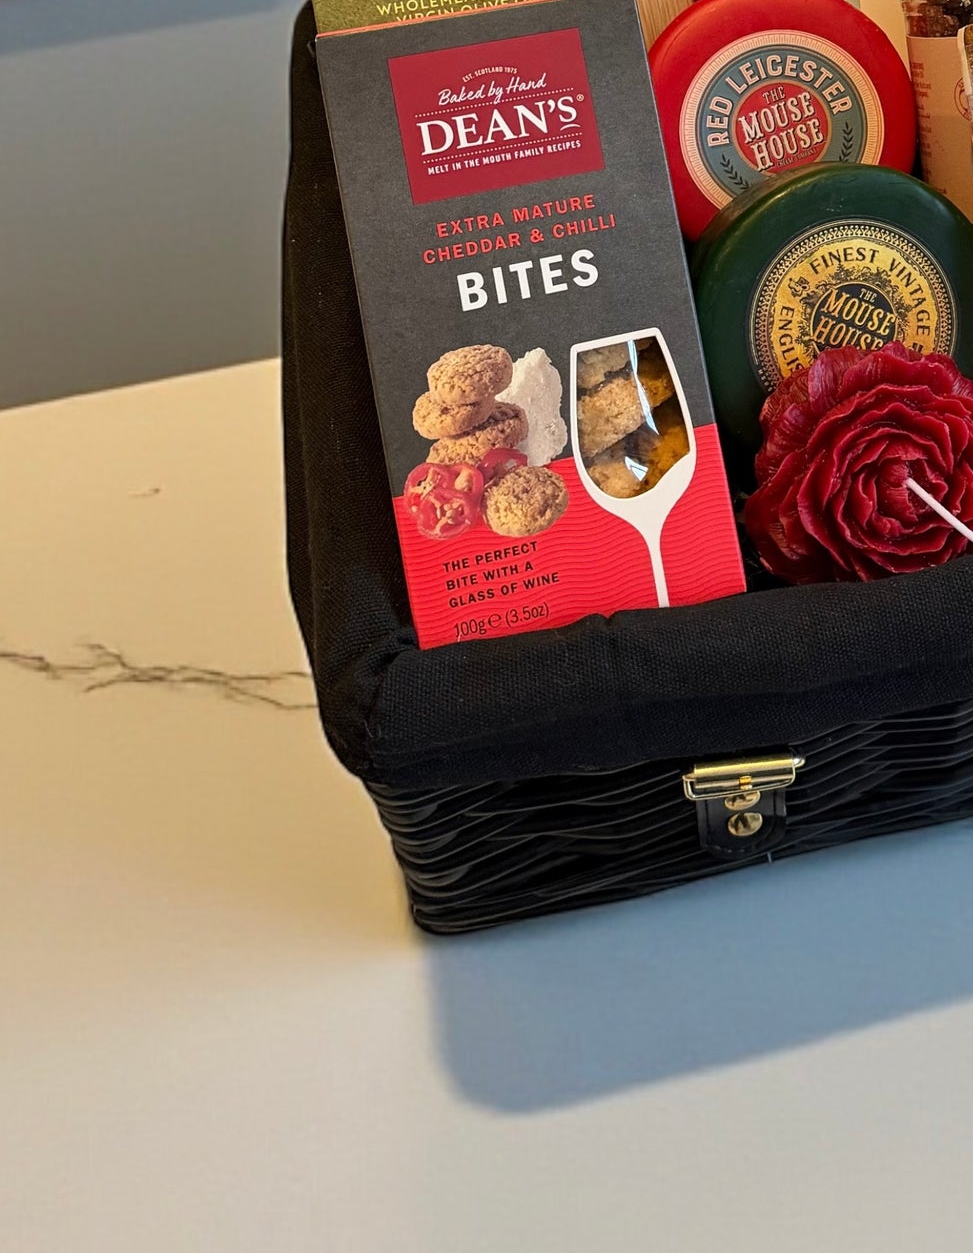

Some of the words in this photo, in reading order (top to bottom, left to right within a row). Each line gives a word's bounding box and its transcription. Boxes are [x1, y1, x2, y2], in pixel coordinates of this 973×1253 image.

[438, 85, 486, 107] Baked
[486, 80, 504, 105] by
[505, 72, 547, 94] Hand
[474, 66, 503, 77] SCOTLAND
[706, 95, 733, 147] RED
[725, 54, 852, 115] LEICESTER
[762, 85, 786, 104] THE
[738, 91, 816, 144] MOUSE
[427, 160, 450, 176] MELT
[452, 158, 462, 171] IN
[464, 155, 480, 169] THE
[482, 151, 512, 165] MOUTH
[514, 145, 545, 160] FAMILY
[547, 139, 582, 154] RECIPES
[751, 118, 824, 172] HOUSE
[436, 212, 505, 238] EXTRA
[512, 194, 596, 223] MATURE
[423, 233, 521, 264] CHEDDAR
[529, 228, 545, 244] &
[552, 213, 616, 239] CHILLI
[456, 249, 599, 312] BITES
[809, 247, 880, 275] FINEST
[888, 258, 931, 337] VINTAGE
[859, 288, 878, 303] THE
[820, 290, 896, 336] MOUSE
[778, 305, 804, 373] ENGLIS
[443, 558, 470, 573] THE
[475, 541, 538, 565] PERFECT
[446, 574, 478, 590] BITE
[482, 564, 519, 581] WITH
[524, 561, 534, 572] A
[449, 588, 495, 608] GLASS
[500, 582, 518, 596] OF
[523, 572, 560, 590] WINE
[454, 618, 487, 638] 100g
[505, 602, 549, 627] (3.5oz)
